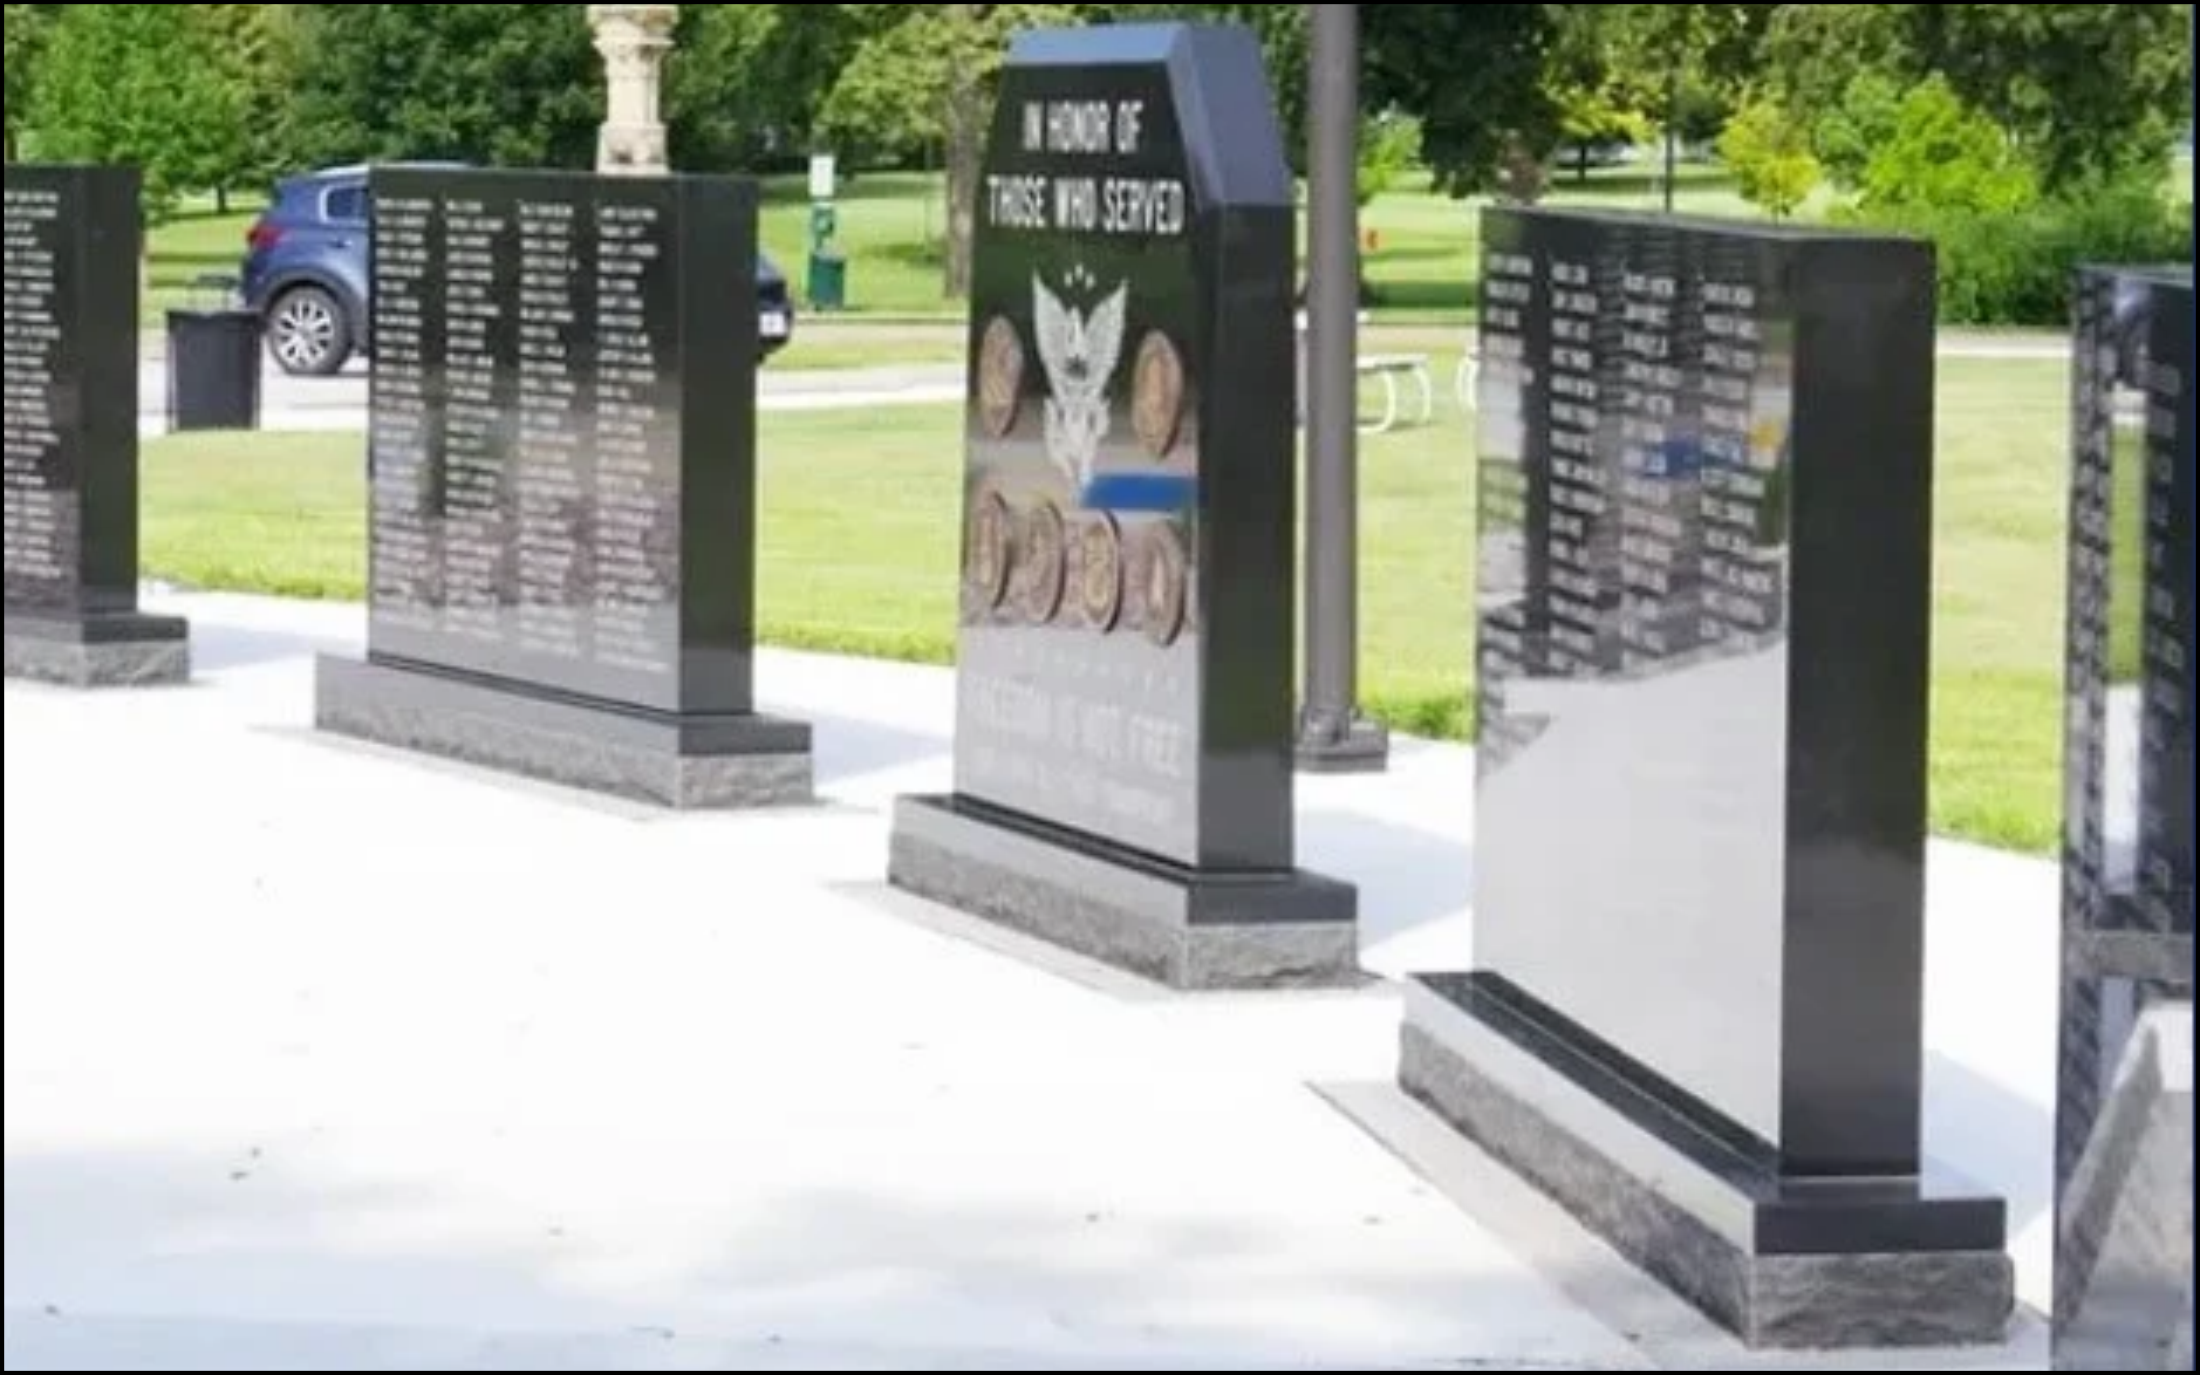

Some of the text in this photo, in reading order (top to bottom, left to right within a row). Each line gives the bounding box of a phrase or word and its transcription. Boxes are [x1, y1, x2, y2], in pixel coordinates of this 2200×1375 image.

[1024, 100, 1143, 153] IN HONOR OF
[987, 174, 1185, 234] THOSE WHO SERVED
